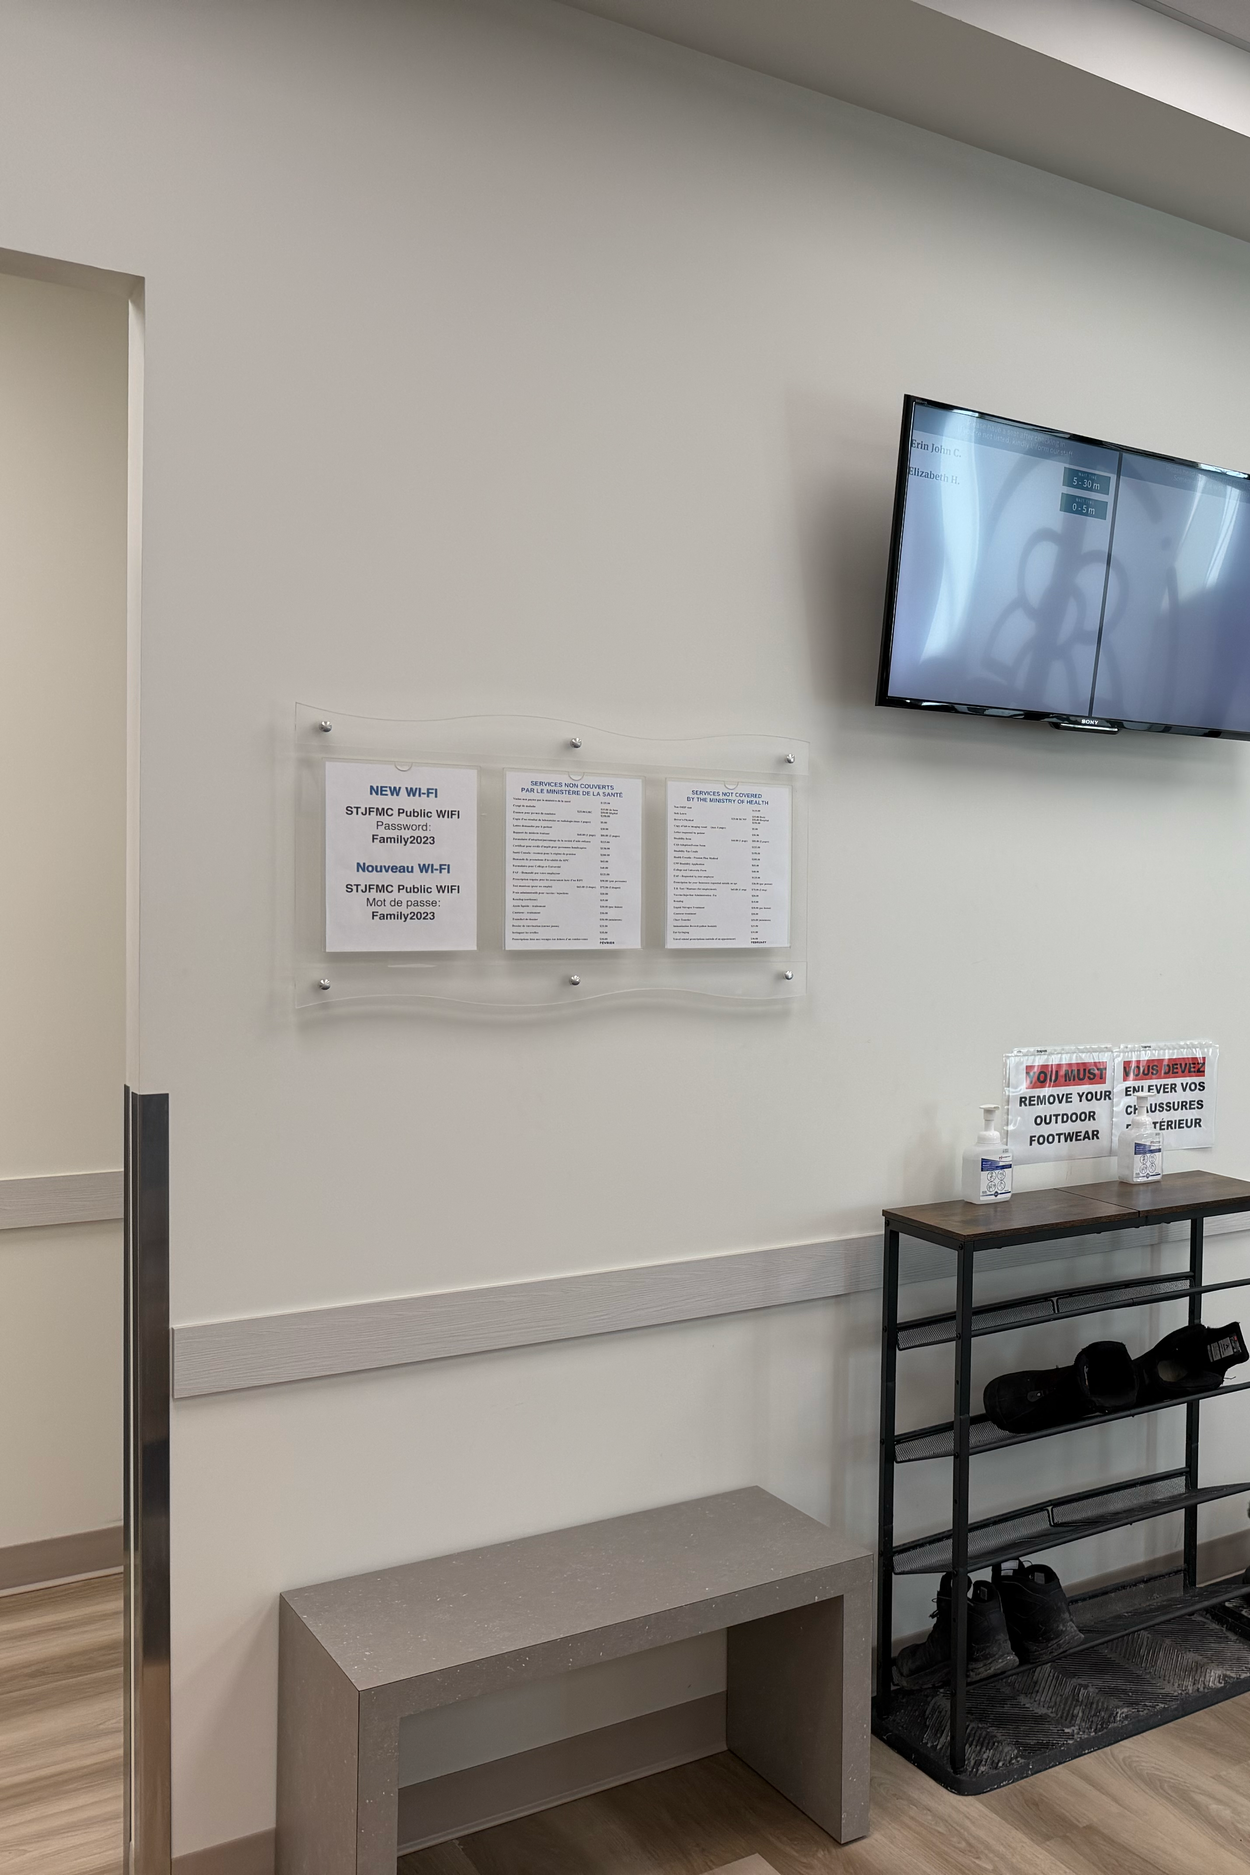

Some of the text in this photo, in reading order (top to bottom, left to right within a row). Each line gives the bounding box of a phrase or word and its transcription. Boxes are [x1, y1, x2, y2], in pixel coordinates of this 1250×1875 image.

[912, 438, 962, 458] Erin John C.
[909, 466, 960, 485] Elizabeth H.
[1072, 476, 1078, 485] 5
[1083, 479, 1092, 488] 30
[1072, 503, 1077, 511] 0
[1082, 505, 1087, 513] 5
[1088, 507, 1095, 515] m
[530, 780, 563, 788] SERVICES
[370, 785, 438, 798] NEW WI-FI
[345, 806, 460, 819] STJFMC Public WIFI
[376, 821, 432, 831] Password:
[372, 834, 435, 846] Family2023
[356, 862, 450, 874] Nouveau WI-FI
[345, 884, 460, 894] STJFMC Public WIFI
[366, 898, 441, 909] Mot de passe:
[372, 911, 435, 922] Family2023
[1124, 1062, 1205, 1077] VOUS DEVEZ
[1026, 1068, 1106, 1084] YOU MUST
[1180, 1081, 1206, 1092] VOS
[1019, 1090, 1112, 1107] REMOVE YOUR
[1125, 1100, 1204, 1115] CHUSSURES
[1034, 1110, 1096, 1126] OUTDOOR
[1029, 1129, 1100, 1146] FOOTWEAR
